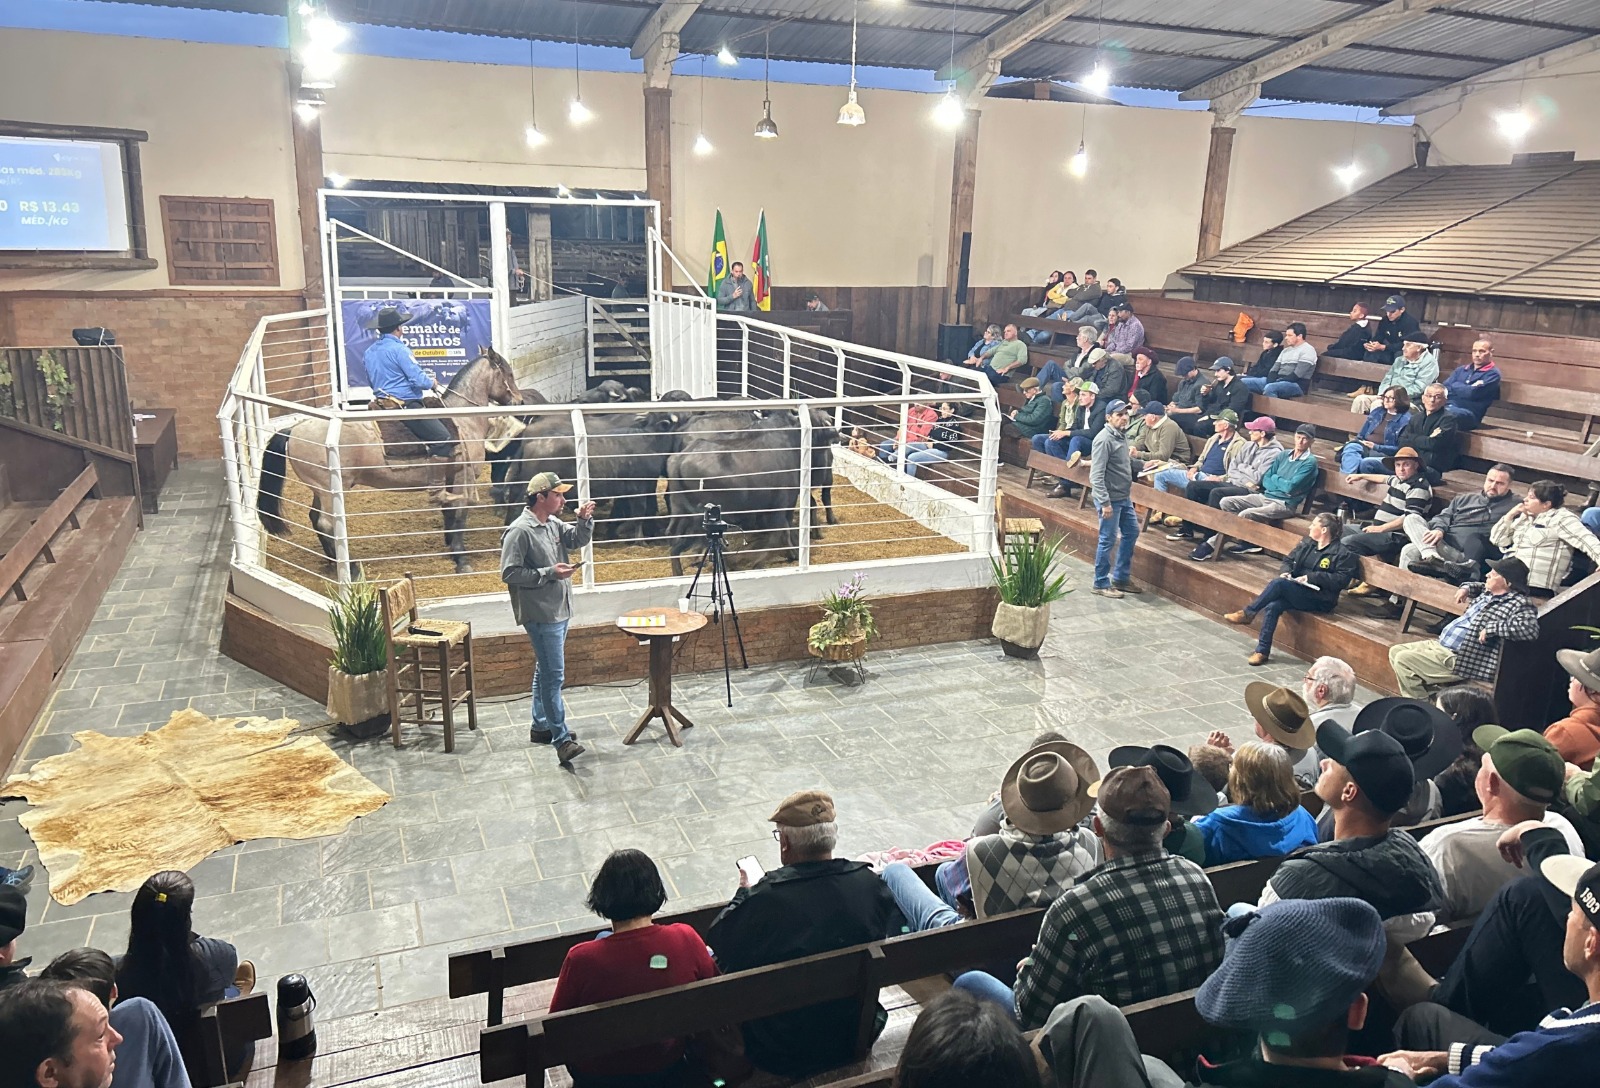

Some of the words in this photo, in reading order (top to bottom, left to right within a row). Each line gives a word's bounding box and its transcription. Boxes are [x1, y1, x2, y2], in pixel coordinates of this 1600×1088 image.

[0, 166, 15, 175] as
[20, 201, 39, 213] R$
[42, 201, 79, 213] 13.43
[21, 216, 69, 226] MÉD./KG
[402, 323, 446, 334] emate
[400, 335, 461, 347] balinos
[422, 349, 445, 357] Outubro
[1579, 886, 1600, 914] 1903
